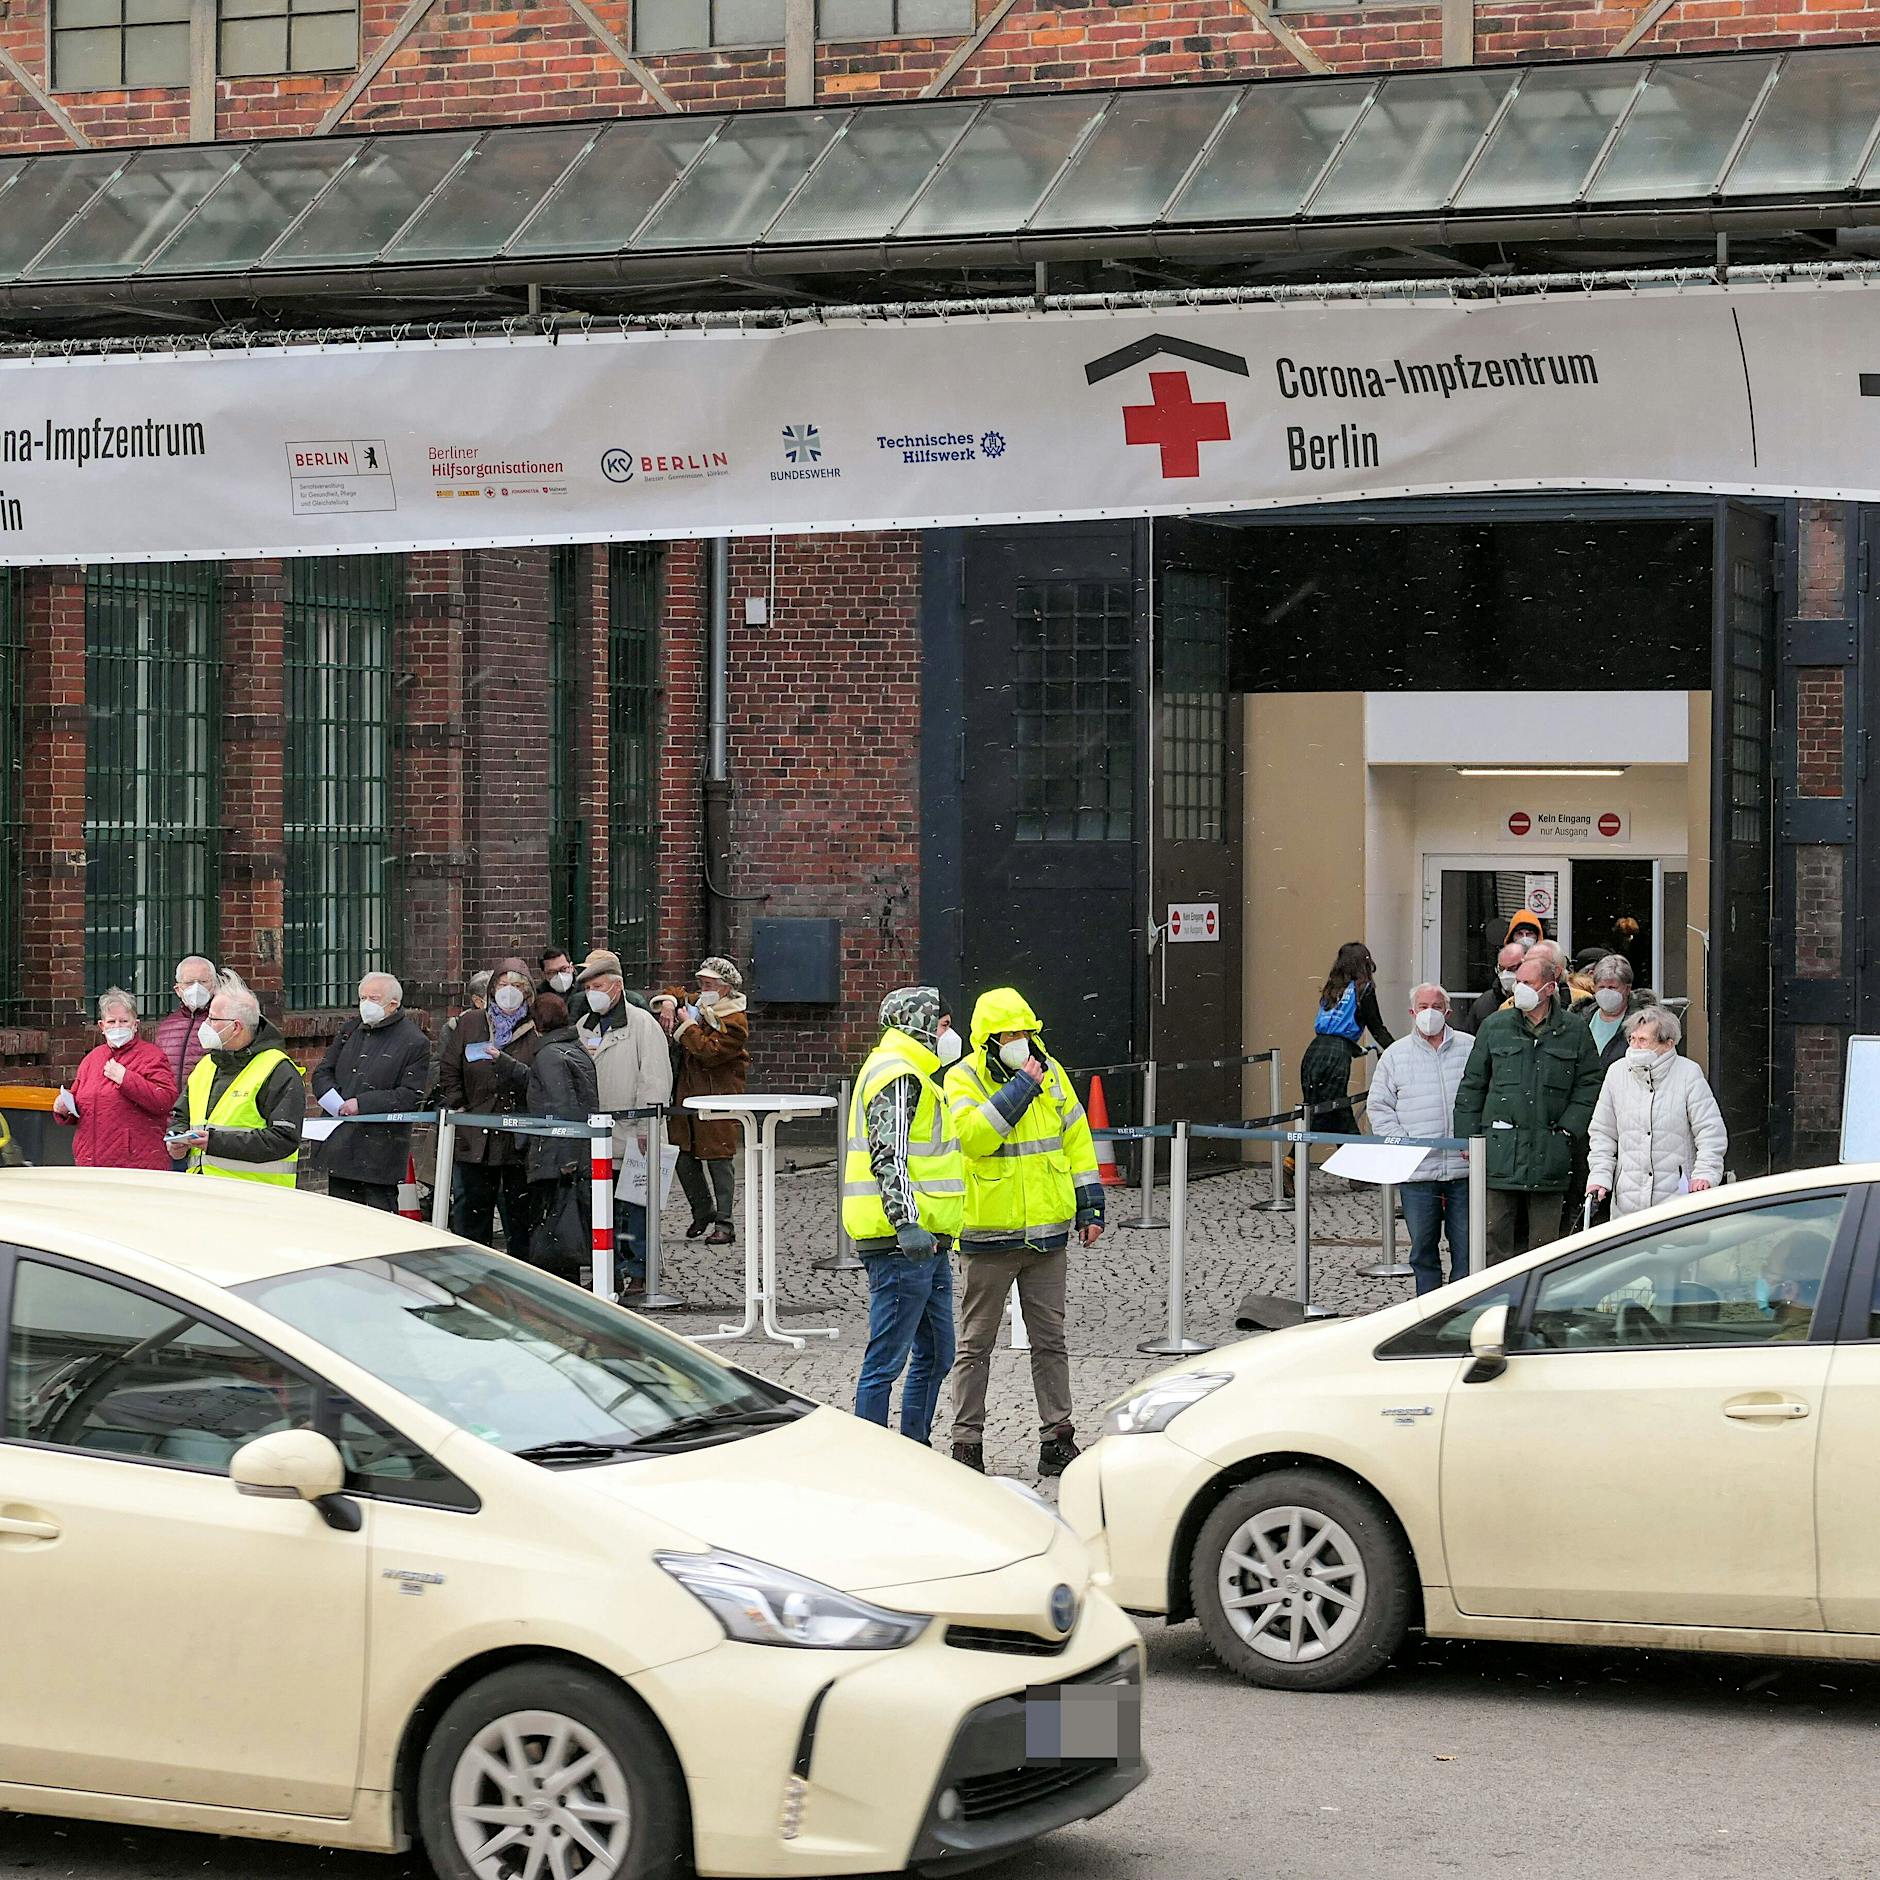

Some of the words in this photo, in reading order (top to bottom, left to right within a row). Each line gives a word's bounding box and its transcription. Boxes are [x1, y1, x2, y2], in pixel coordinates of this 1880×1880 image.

[1276, 353, 1599, 398] Corona-Impfzentrum
[0, 418, 206, 467] na-Impfzentrum
[877, 433, 974, 449] Technisches
[1287, 424, 1379, 471] Berlin
[295, 452, 349, 467] BERLIN
[428, 446, 479, 460] Berliner
[903, 448, 976, 463] Hilfswerk
[432, 460, 564, 478] Hilfsorganisationen
[640, 452, 728, 472] BERLIN
[770, 468, 841, 481] BUNDESWEHR
[1538, 814, 1556, 823] Kein
[1558, 814, 1591, 824] Eingang
[1540, 828, 1552, 836] nur
[1555, 827, 1588, 837] Ausgang
[386, 1113, 404, 1121] BER
[502, 1118, 519, 1127] BER
[551, 1127, 567, 1135] BER
[1287, 1132, 1303, 1141] BER
[1384, 1136, 1401, 1144] BER
